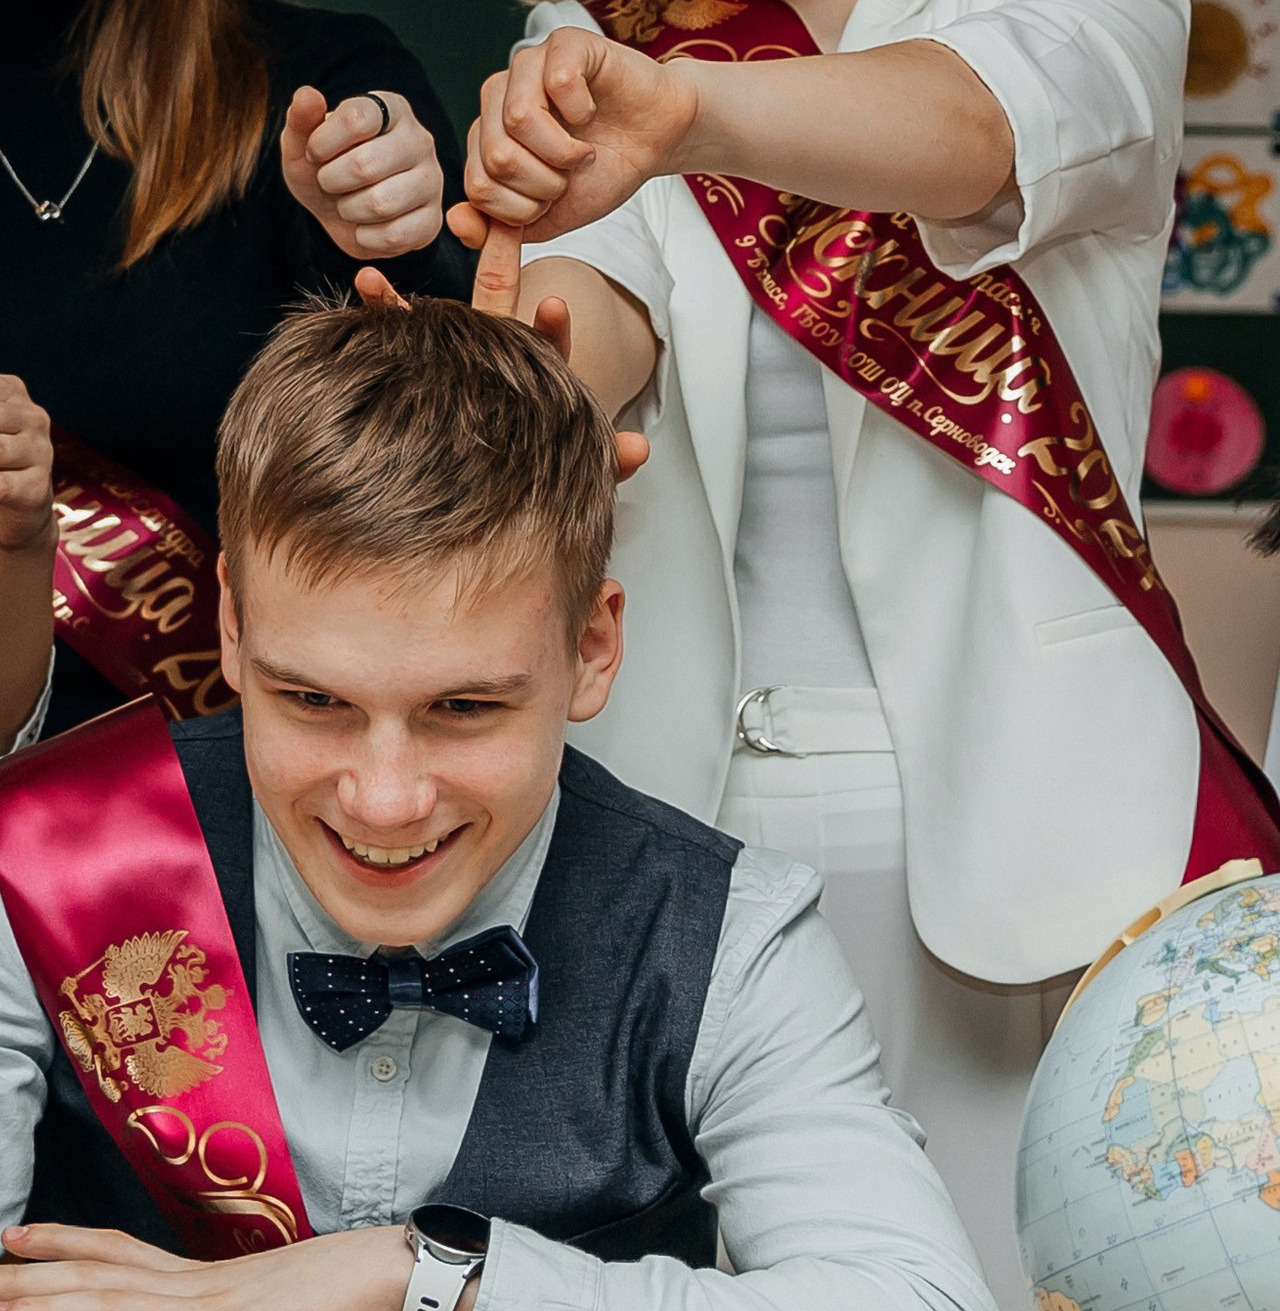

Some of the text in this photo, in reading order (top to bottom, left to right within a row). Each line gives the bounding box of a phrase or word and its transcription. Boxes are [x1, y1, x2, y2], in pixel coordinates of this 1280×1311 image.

[791, 304, 843, 346] ГБОУ
[880, 376, 914, 406] ОЦ
[923, 406, 1017, 475] Серноводск
